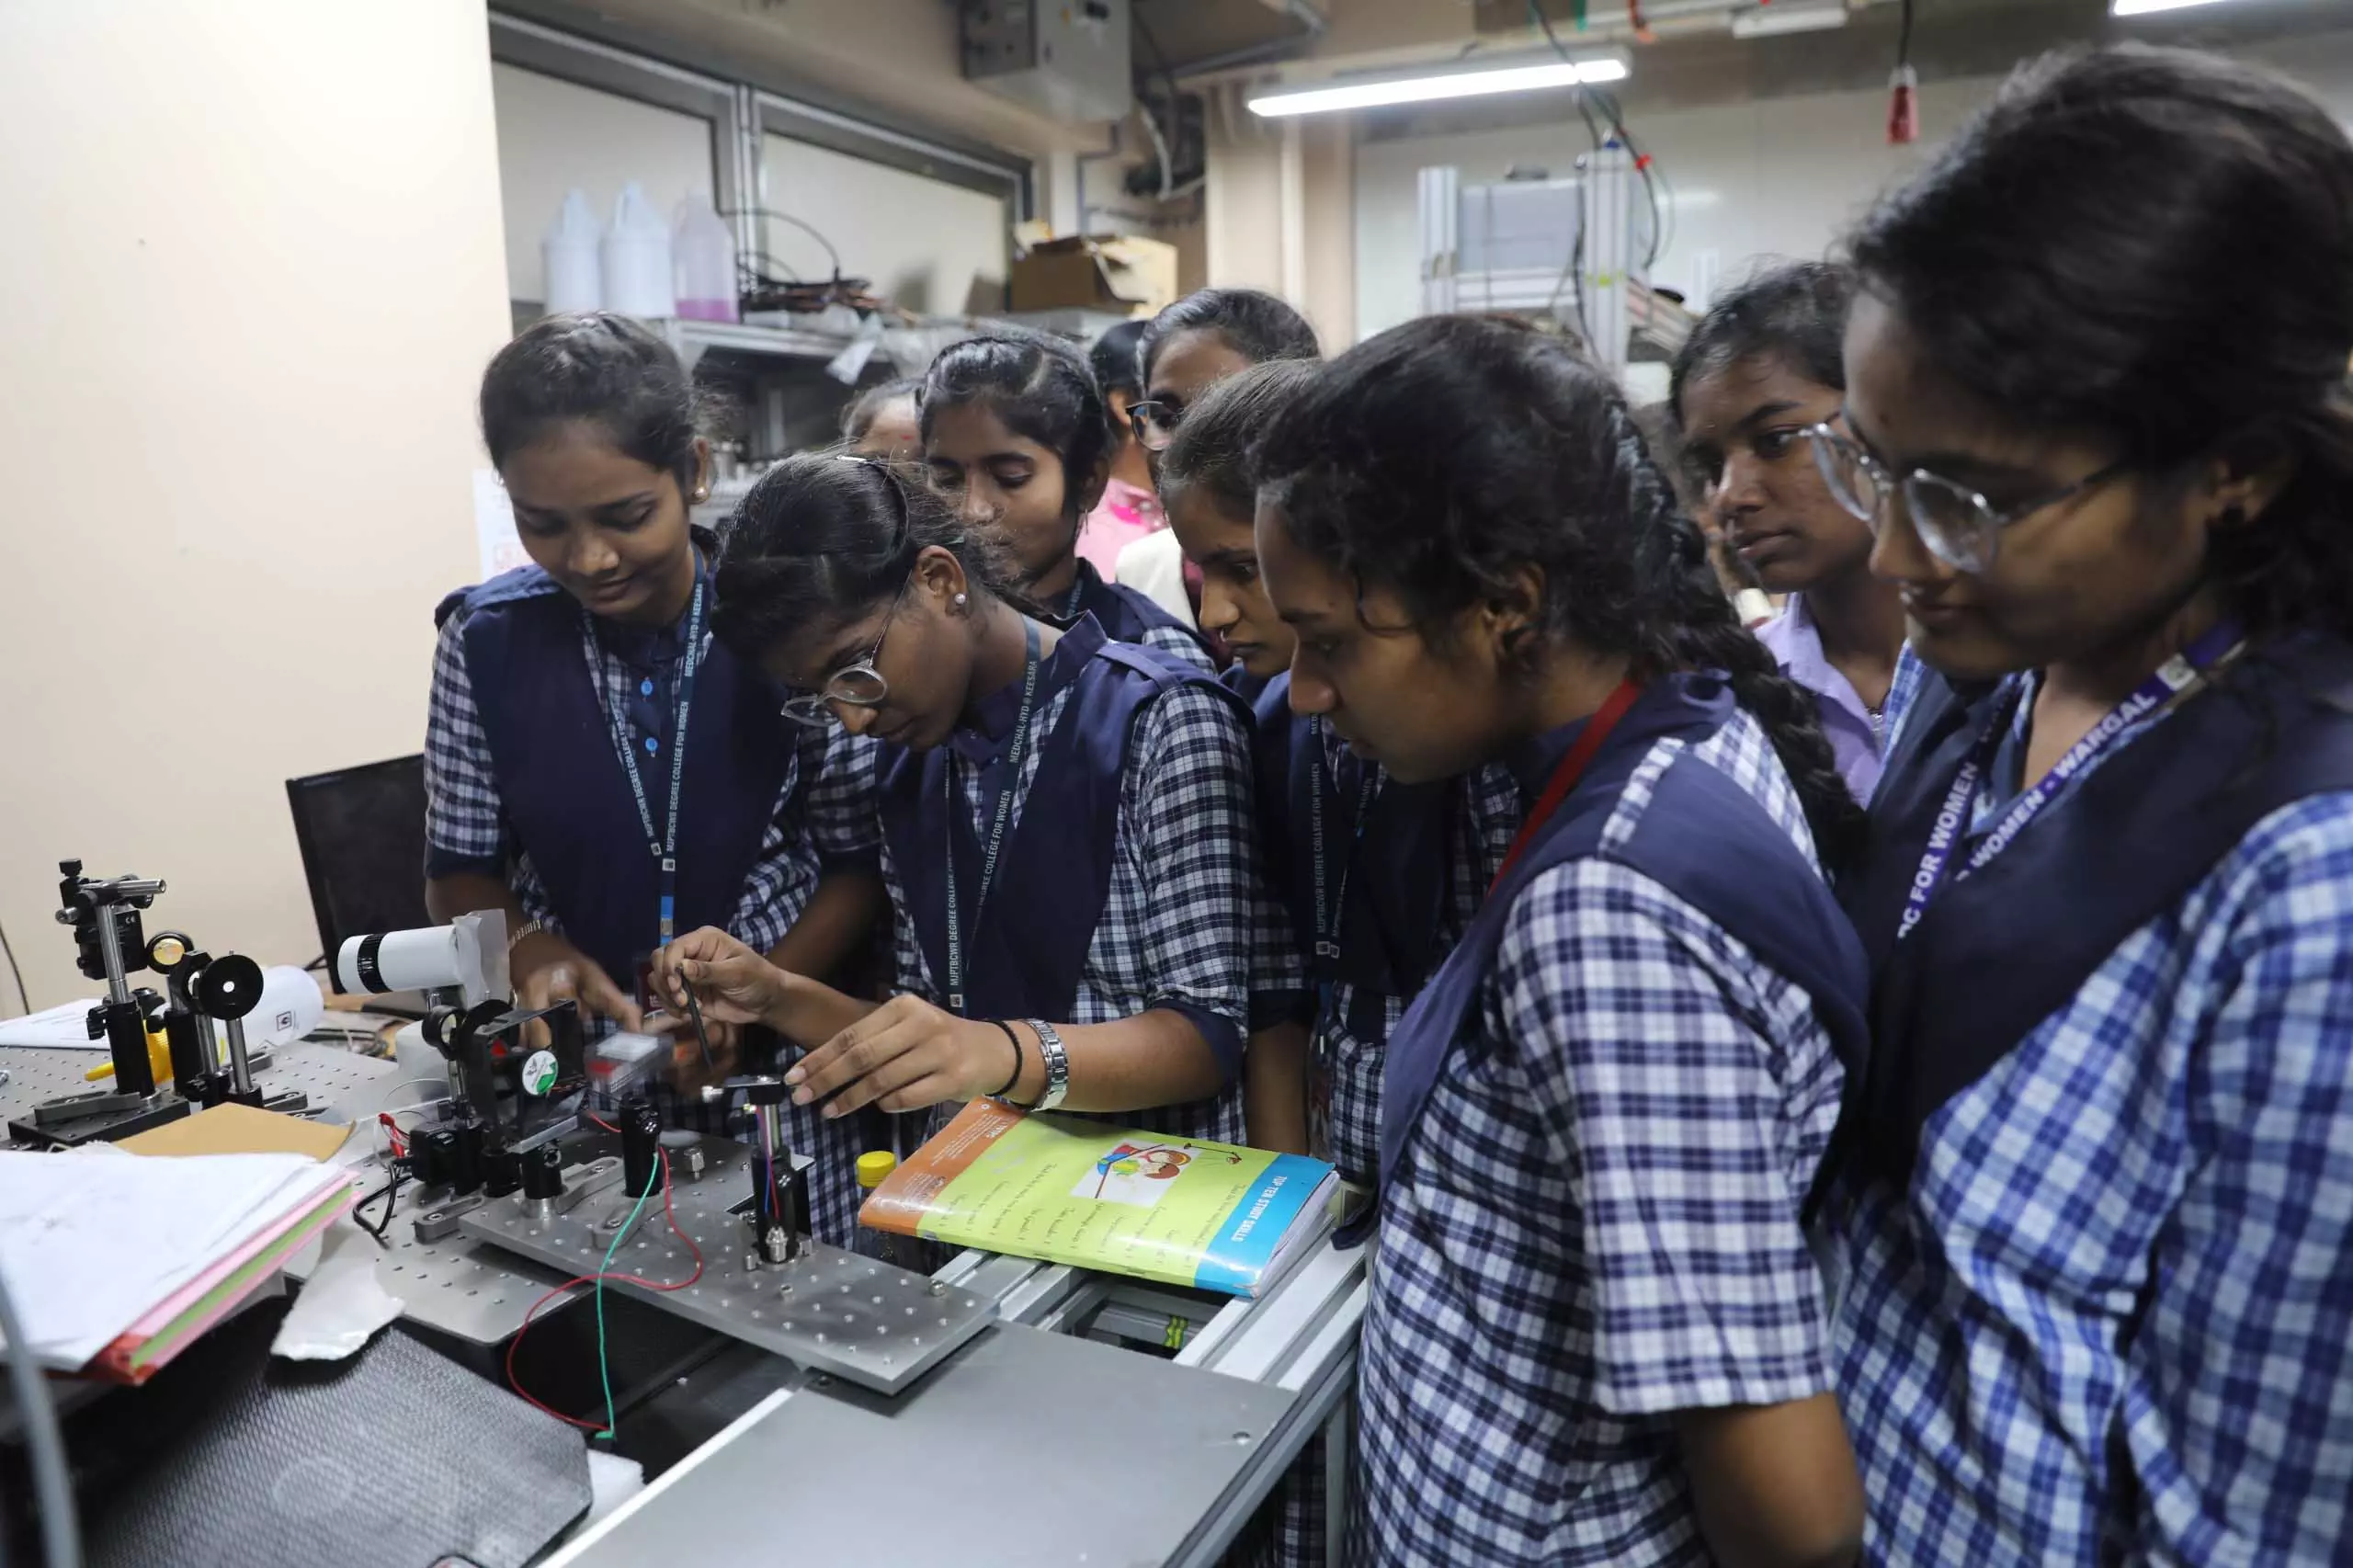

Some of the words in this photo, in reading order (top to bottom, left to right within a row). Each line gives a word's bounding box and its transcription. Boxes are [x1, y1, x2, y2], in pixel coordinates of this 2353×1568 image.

[678, 701, 688, 730] WOMEN
[1009, 705, 1029, 763] MEDCHAL-HYD
[1024, 661, 1038, 697] KEESARA
[620, 735, 635, 768] COLLEGE
[676, 732, 685, 745] FOR
[672, 746, 683, 780] COLLEGE
[629, 768, 643, 798] DEGREE
[670, 780, 679, 810] DEGREE
[1970, 789, 2046, 868] WOMEN
[2053, 692, 2157, 778] WARGAL
[995, 790, 1012, 821] WOMEN
[993, 823, 1004, 838] FOR
[1910, 854, 1942, 903] FOR
[1927, 761, 1978, 849] WOMEN
[984, 838, 999, 874] COLLEGE
[949, 909, 958, 941] DEGREE
[1261, 1187, 1279, 1199] TEN
[1272, 1176, 1288, 1187] TOP
[1246, 1198, 1270, 1221] STUDY
[1231, 1220, 1256, 1243] SKILLS
